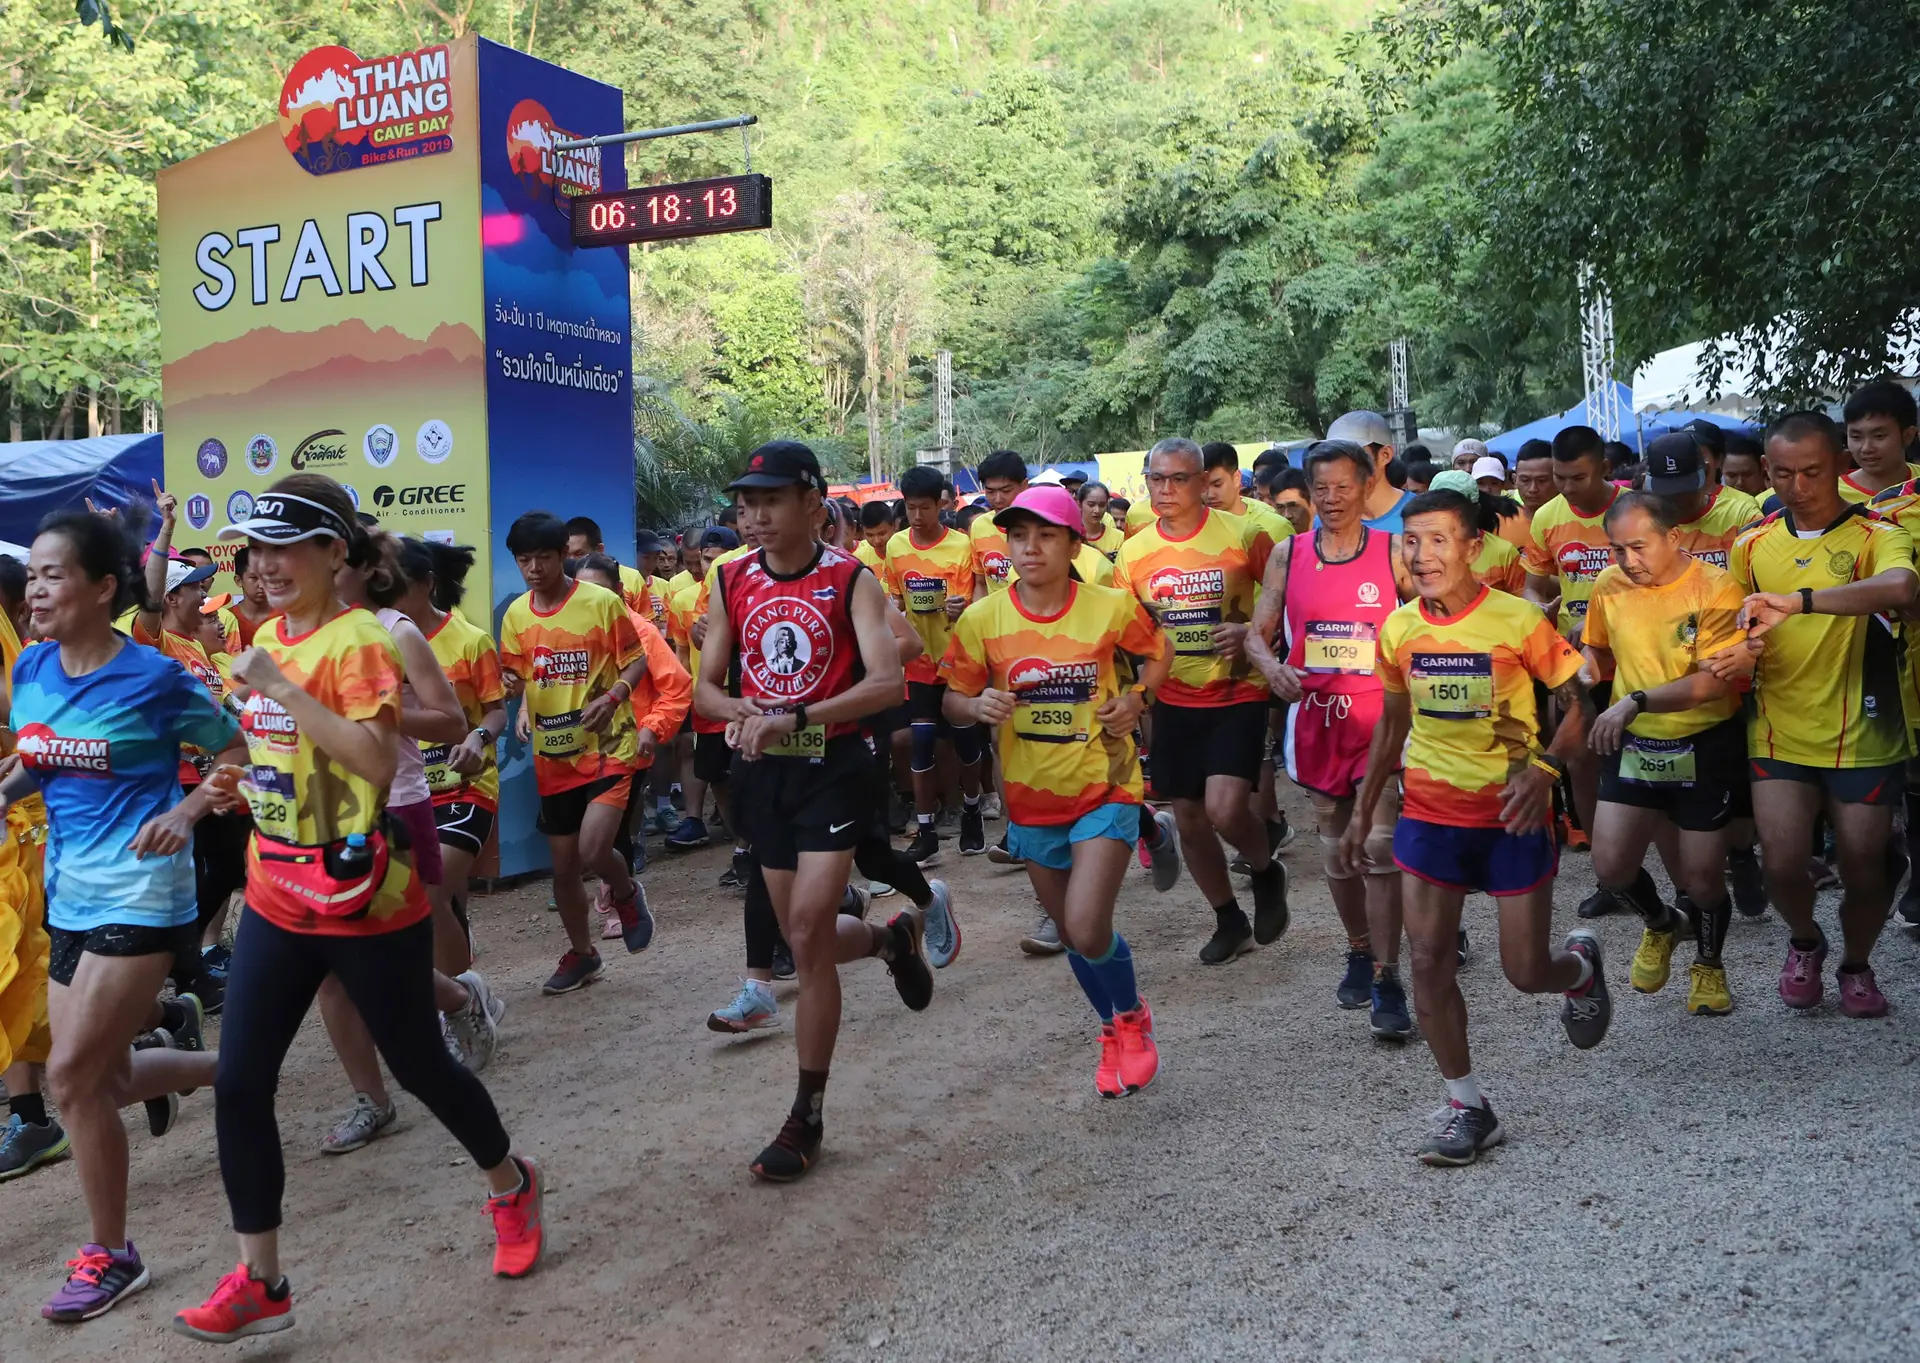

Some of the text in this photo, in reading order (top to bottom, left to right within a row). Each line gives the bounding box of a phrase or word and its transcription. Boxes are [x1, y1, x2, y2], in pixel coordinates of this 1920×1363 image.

[352, 50, 447, 95] THAM
[339, 82, 448, 130] LUANG
[373, 115, 449, 143] CAVE DAY
[361, 138, 451, 165] Bike&Run 2019
[541, 151, 600, 189] LUANG
[192, 201, 442, 312] START
[495, 298, 525, 326] วิ่ง-ปั่น
[536, 311, 544, 330] ปี
[546, 317, 621, 345] เหตุการณ์ถ้ำหลวง
[399, 484, 466, 505] GREE
[402, 507, 466, 516] Conditioners
[1180, 571, 1221, 584] THAM
[1174, 581, 1222, 595] LUANG
[913, 595, 934, 604] 2399
[748, 604, 825, 640] SIANG PURE
[1168, 611, 1209, 621] GARMIN
[1316, 623, 1363, 633] GARMIN
[1176, 630, 1209, 643] 2805
[551, 652, 587, 664] THAM
[1322, 645, 1358, 659] 1029
[546, 662, 587, 675] LUANG
[1421, 657, 1474, 667] GARMIN
[1047, 663, 1097, 679] THAM
[1429, 684, 1468, 700] 1501
[253, 715, 296, 732] LUANG
[1031, 710, 1072, 725] 2539
[544, 733, 574, 747] 2826
[781, 732, 823, 748] 0136
[48, 739, 108, 757] THAM
[1639, 757, 1675, 772] 2691
